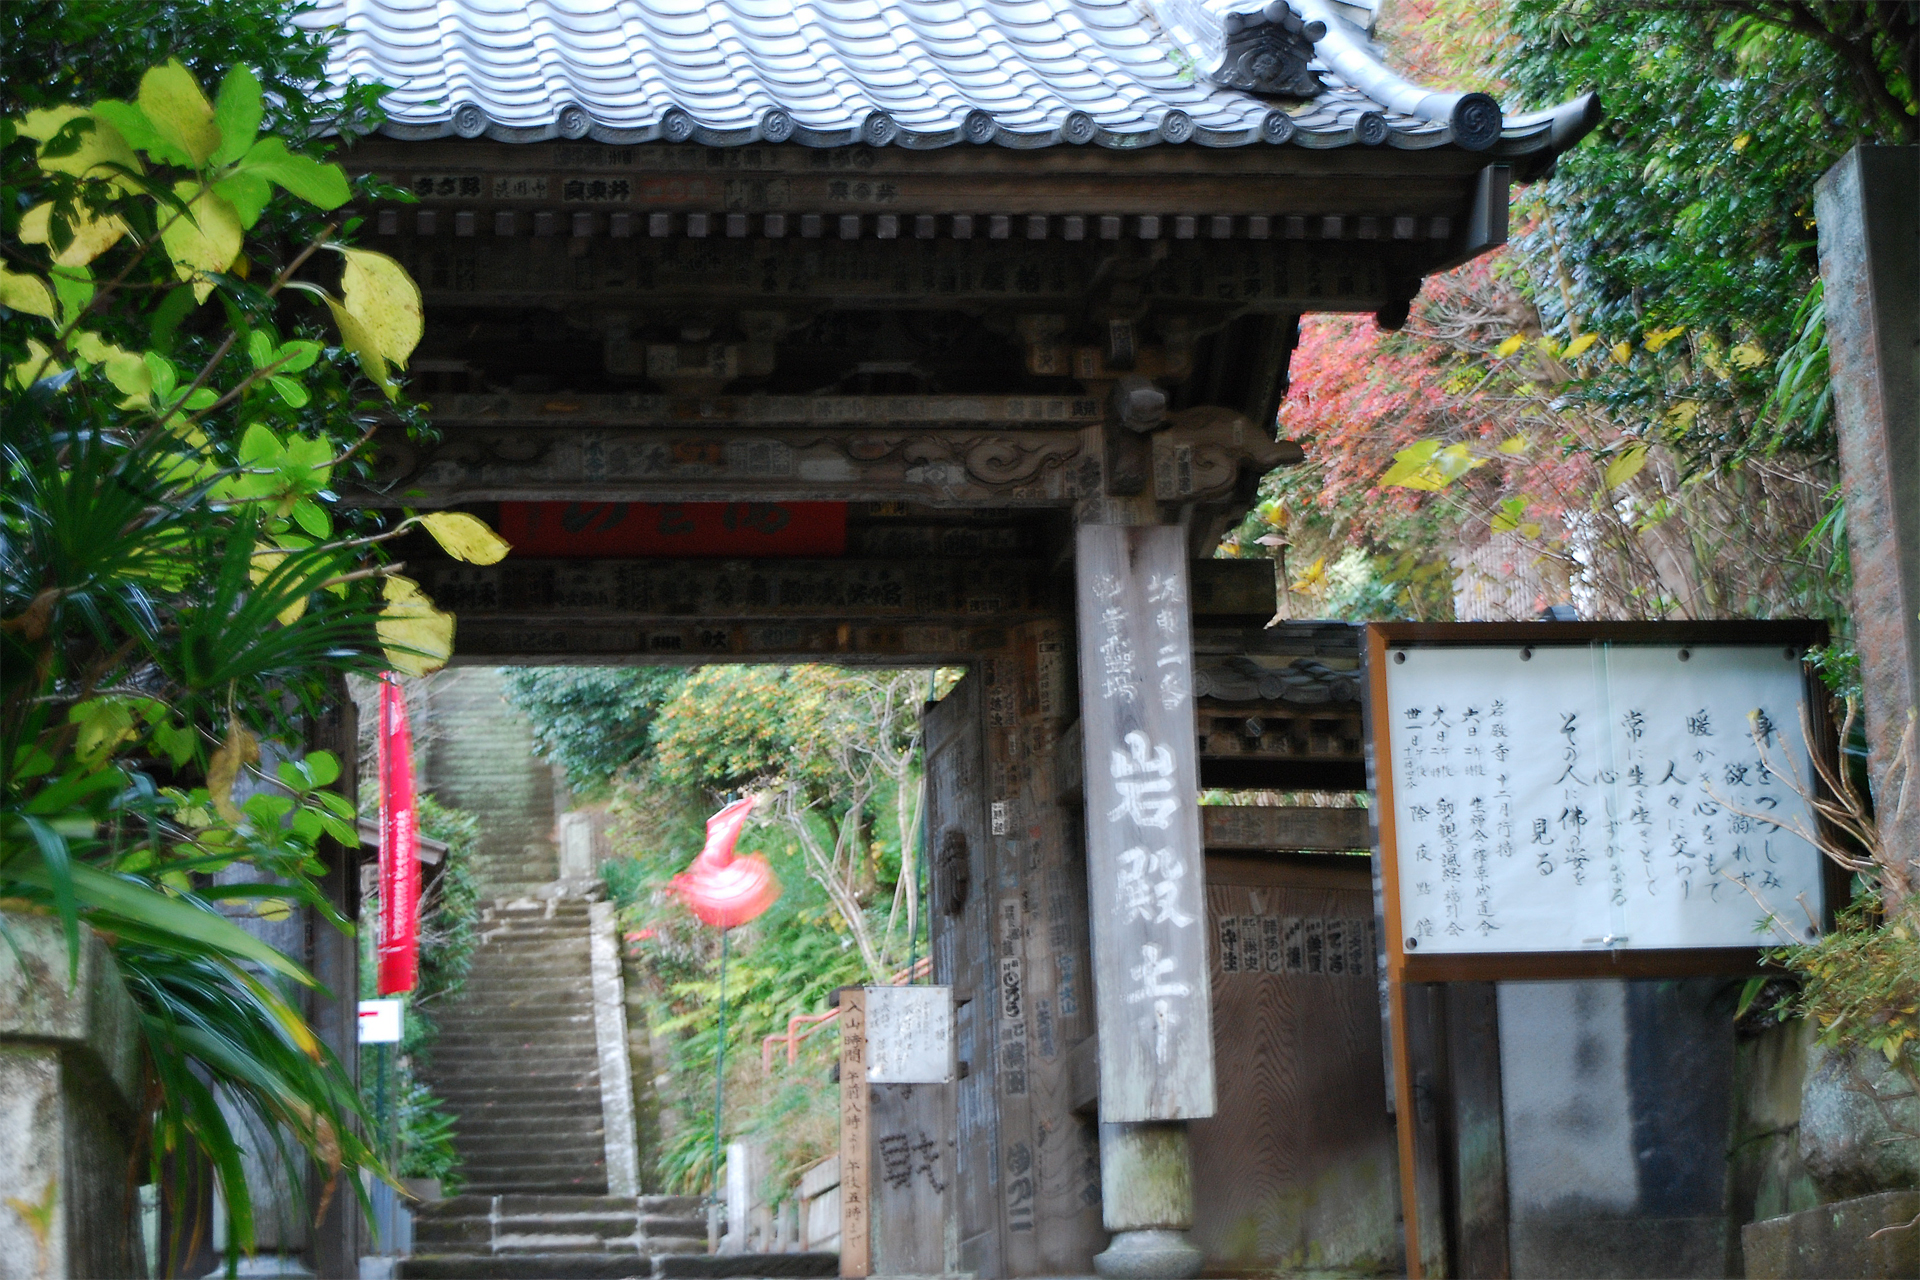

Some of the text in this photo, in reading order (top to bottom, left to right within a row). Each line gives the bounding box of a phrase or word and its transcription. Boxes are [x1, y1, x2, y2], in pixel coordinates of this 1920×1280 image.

[1461, 706, 1480, 737] 六日
[1488, 699, 1509, 762] 岩殿寺
[1531, 817, 1555, 876] 見る
[1657, 760, 1696, 900] 人々に交わり
[1723, 763, 1754, 895] 欲に溺れず
[1746, 707, 1782, 889] 身をつつしみ
[1105, 729, 1196, 1065] 岩殿寺
[844, 1000, 864, 1063] 入山時間
